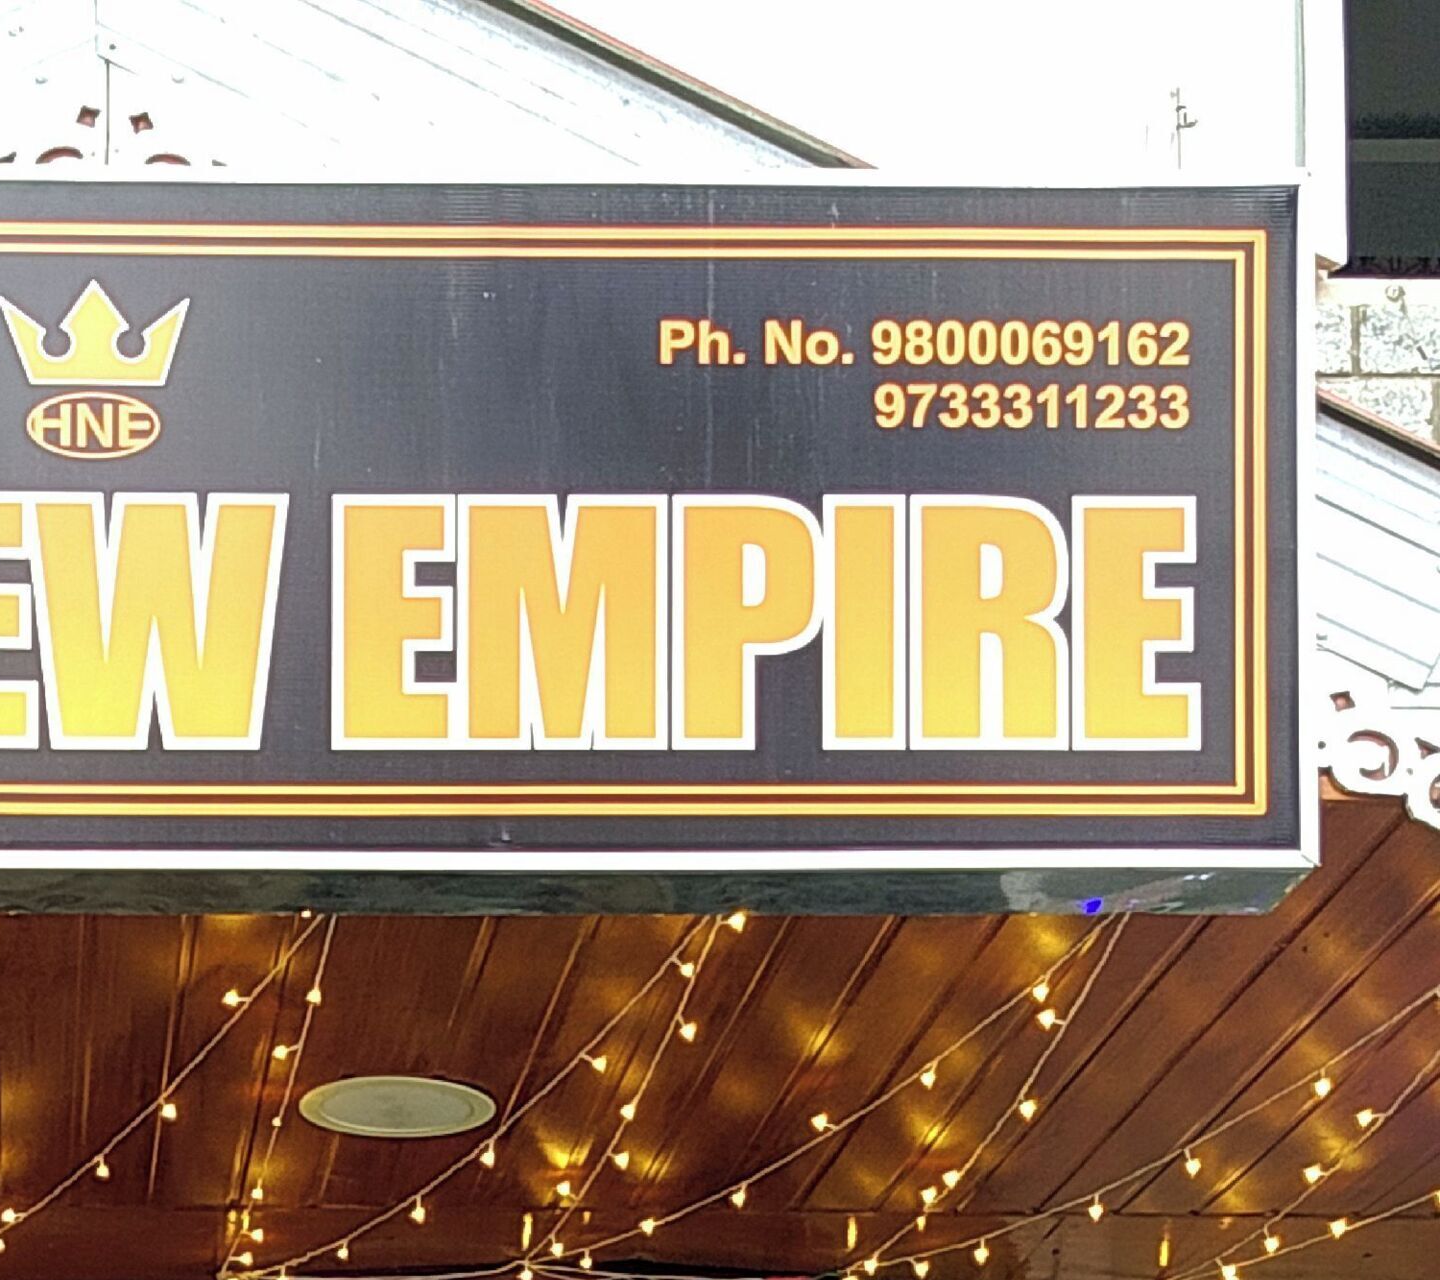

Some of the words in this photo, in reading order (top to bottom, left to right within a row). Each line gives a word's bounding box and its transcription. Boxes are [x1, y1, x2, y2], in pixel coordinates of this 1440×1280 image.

[660, 319, 747, 365] Ph.
[764, 319, 854, 365] No.
[871, 319, 1191, 366] 9800069162
[33, 402, 155, 448] HNE
[874, 383, 1191, 429] 9733311233
[329, 493, 1203, 752] EMPIRE
